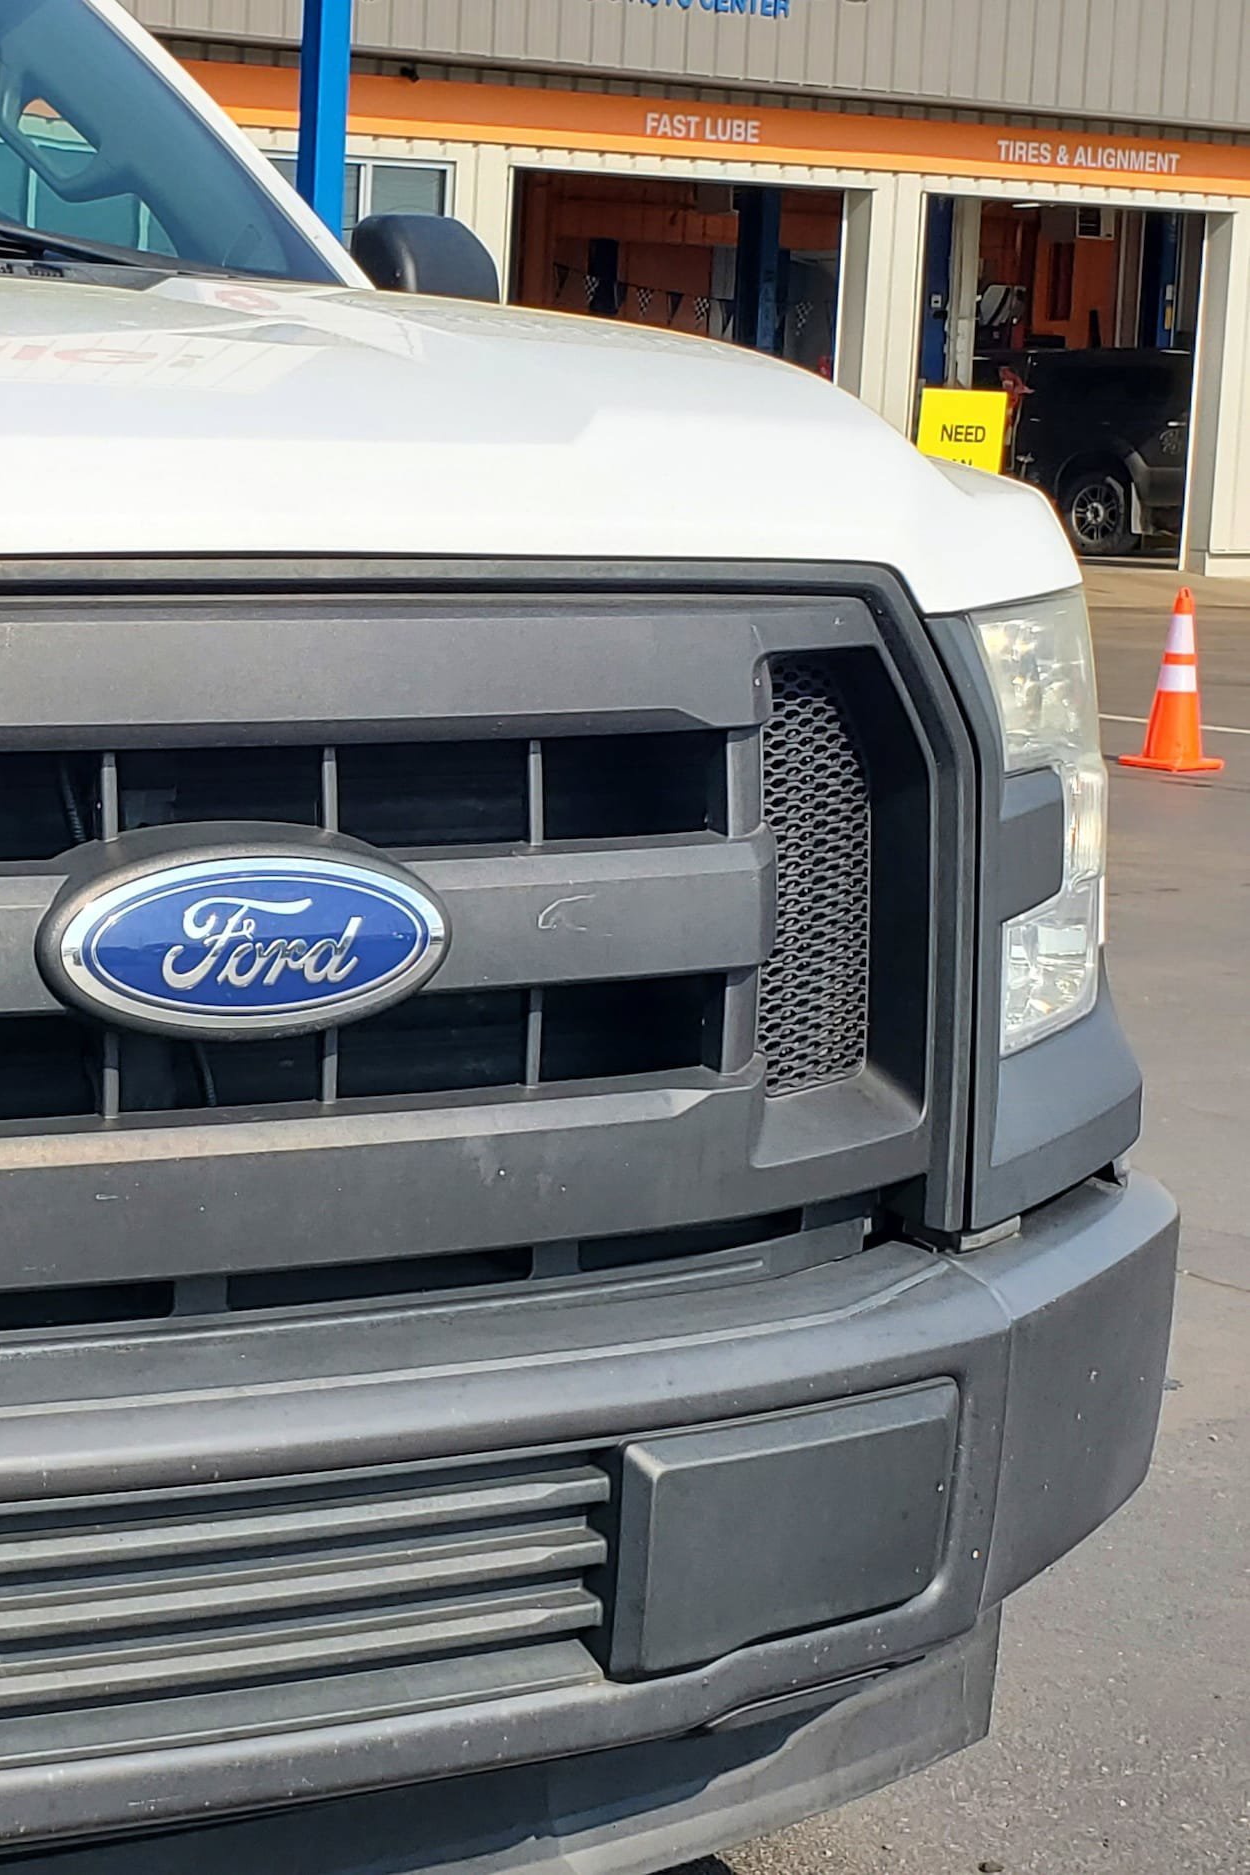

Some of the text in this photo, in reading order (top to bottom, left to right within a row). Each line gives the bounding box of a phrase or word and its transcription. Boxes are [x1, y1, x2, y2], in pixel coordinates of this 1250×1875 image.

[646, 112, 761, 143] FAST LUBE
[997, 140, 1180, 174] TIRES & ALIGNMENT
[940, 424, 986, 443] NEED
[161, 896, 363, 990] Ford
